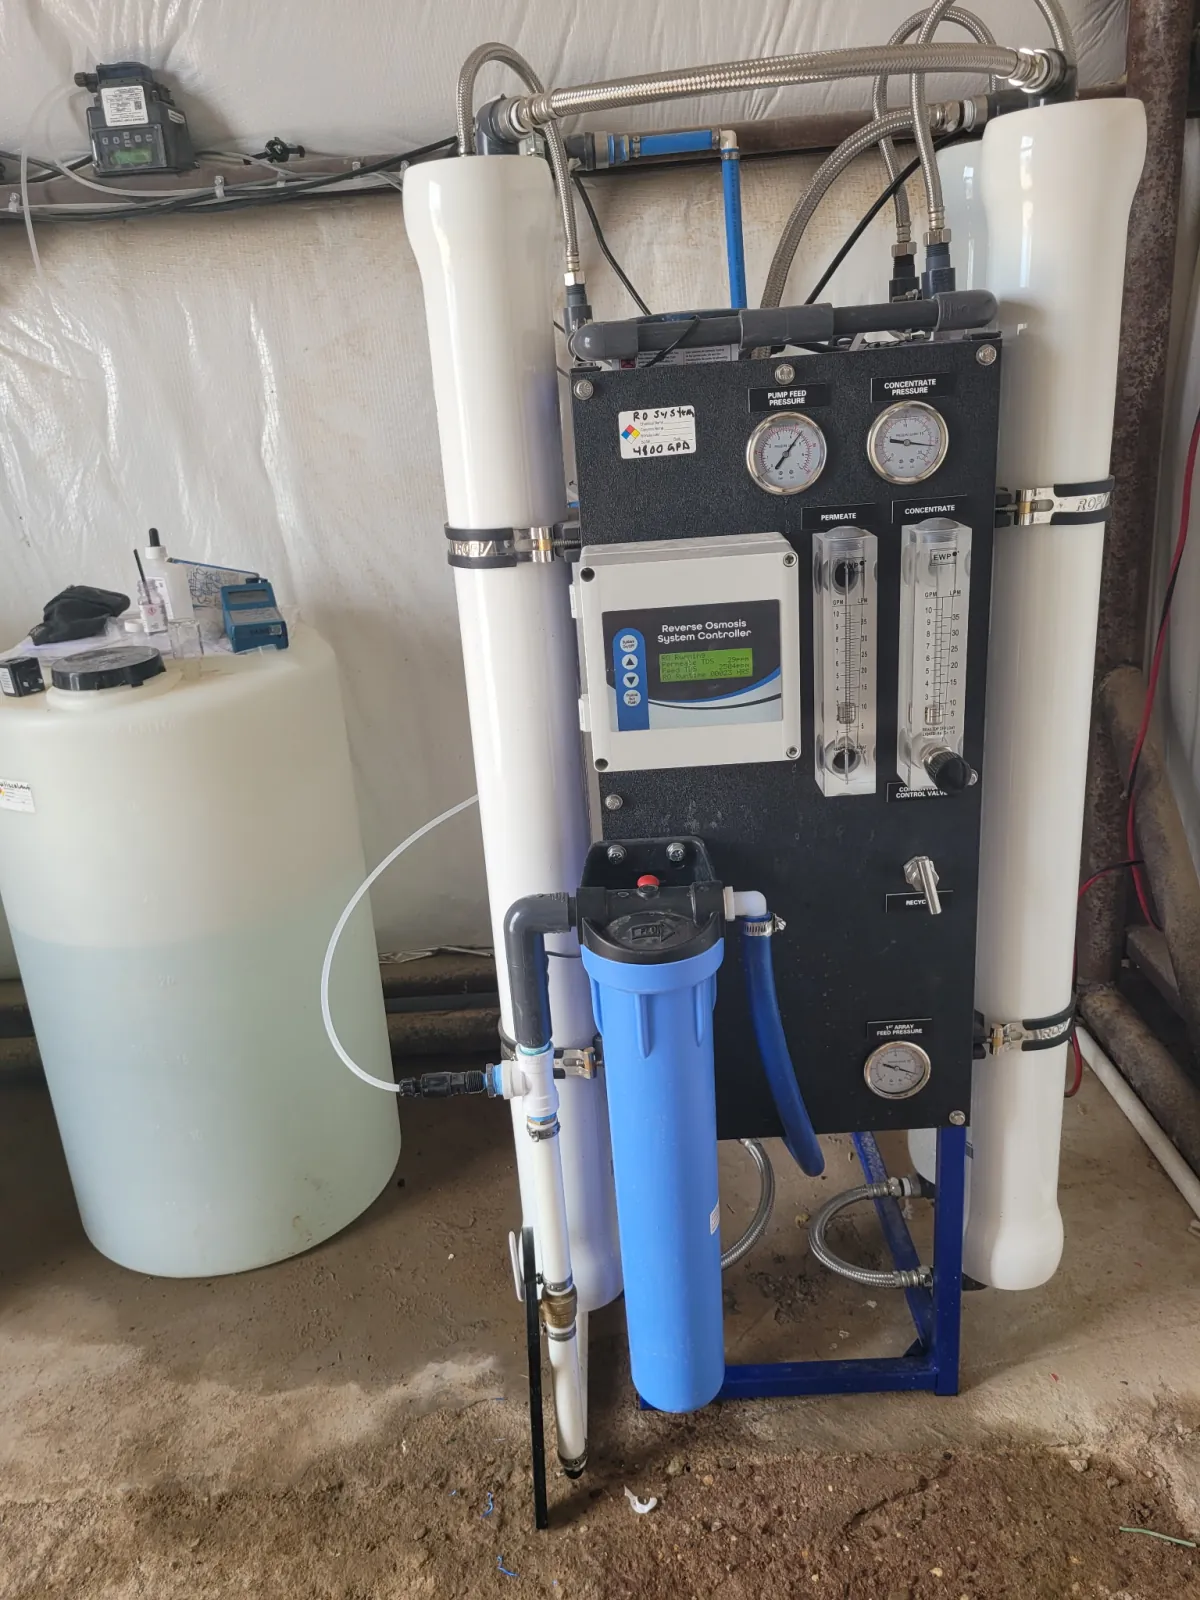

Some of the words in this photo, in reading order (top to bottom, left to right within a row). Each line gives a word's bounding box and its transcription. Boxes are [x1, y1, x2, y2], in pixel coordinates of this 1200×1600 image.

[884, 379, 936, 389] CONCENTRATE
[768, 391, 788, 399] PUMP
[892, 387, 928, 396] PRESSURE
[769, 398, 806, 406] PRESSURE
[904, 504, 956, 514] CONCENTRATE
[820, 512, 856, 520] PERMEATE
[933, 553, 952, 561] EWP
[925, 606, 932, 614] 10
[662, 622, 702, 632] Reverse
[705, 619, 747, 630] Osmosis
[926, 618, 930, 626] 9
[658, 632, 695, 644] System
[698, 630, 752, 640] Controller
[926, 630, 930, 638] 8
[926, 642, 930, 650] 7
[950, 678, 958, 686] 15
[892, 1028, 923, 1036] PRESSURE
